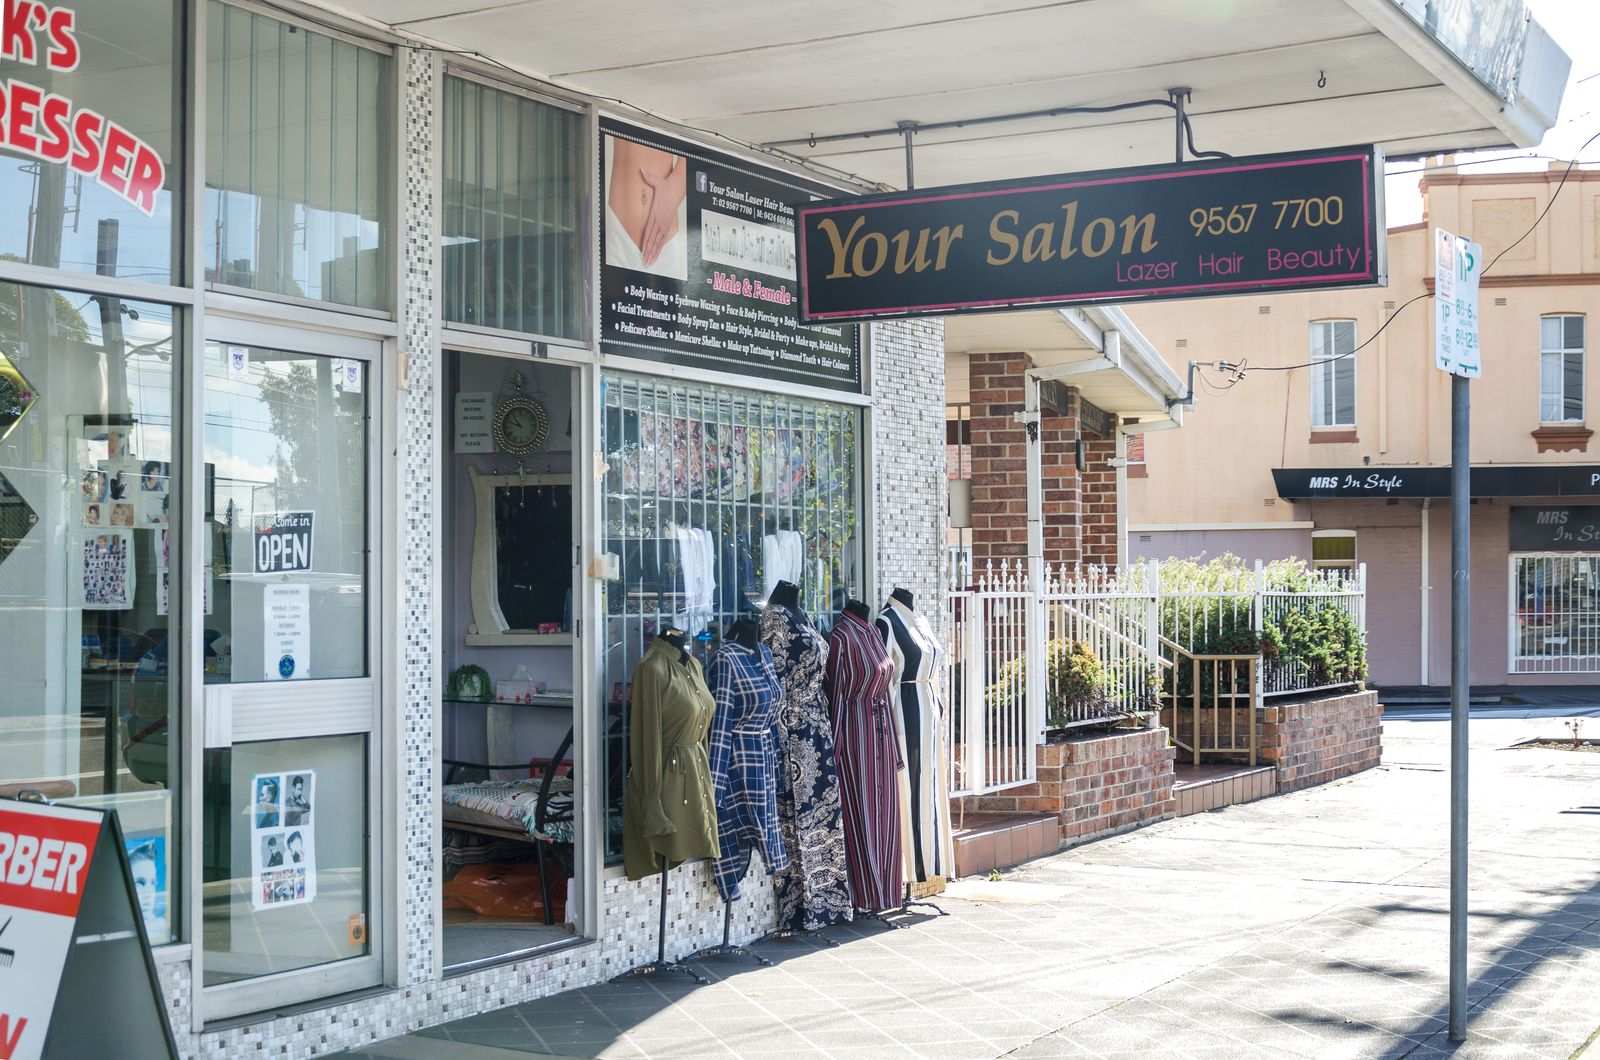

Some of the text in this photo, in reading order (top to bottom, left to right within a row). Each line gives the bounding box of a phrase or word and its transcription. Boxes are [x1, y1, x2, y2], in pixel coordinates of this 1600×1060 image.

[0, 77, 165, 218] ESSER
[709, 181, 726, 194] Your
[726, 187, 744, 202] Salon
[745, 192, 763, 206] Laser
[764, 197, 778, 210] Hair
[712, 196, 718, 206] T:
[718, 199, 726, 208] 02
[726, 200, 739, 212] 9567
[740, 204, 752, 215] 7700
[756, 209, 764, 218] M:
[764, 212, 776, 222] 0424
[817, 195, 1344, 280] Your Salon 9567 7700
[1116, 243, 1361, 283] Lazer Hair Beauty
[712, 271, 742, 294] Male
[742, 278, 752, 297] &
[753, 280, 791, 306] Female
[630, 285, 646, 301] Body
[646, 288, 668, 306] Waxing
[674, 294, 700, 308] Eyebrow
[700, 298, 720, 316] Waxing
[726, 304, 738, 316] Face
[738, 307, 744, 317] &
[744, 307, 758, 322] Body
[758, 310, 778, 327] Piercing
[784, 316, 797, 330] Body
[1442, 303, 1451, 323] 1P
[617, 302, 636, 315] Facial
[636, 305, 671, 321] Treatments
[677, 312, 692, 328] Body
[692, 315, 709, 331] Spray
[709, 318, 720, 330] Tan
[726, 322, 738, 334] Hair
[754, 327, 770, 340] Bridal
[771, 332, 775, 340] &
[776, 332, 790, 346] Party
[795, 335, 809, 347] Make
[819, 340, 834, 352] Bridal
[834, 343, 838, 352] &
[838, 344, 852, 357] Party
[620, 322, 850, 371] Pedicure Shellac Manicure Shellac Make up Tattooing Diamond Tooth Hair Colours
[1309, 474, 1403, 492] MRS In Style
[274, 514, 310, 528] Come in
[1536, 510, 1570, 525] MRS
[1552, 526, 1573, 541] In
[258, 533, 308, 571] OPEN
